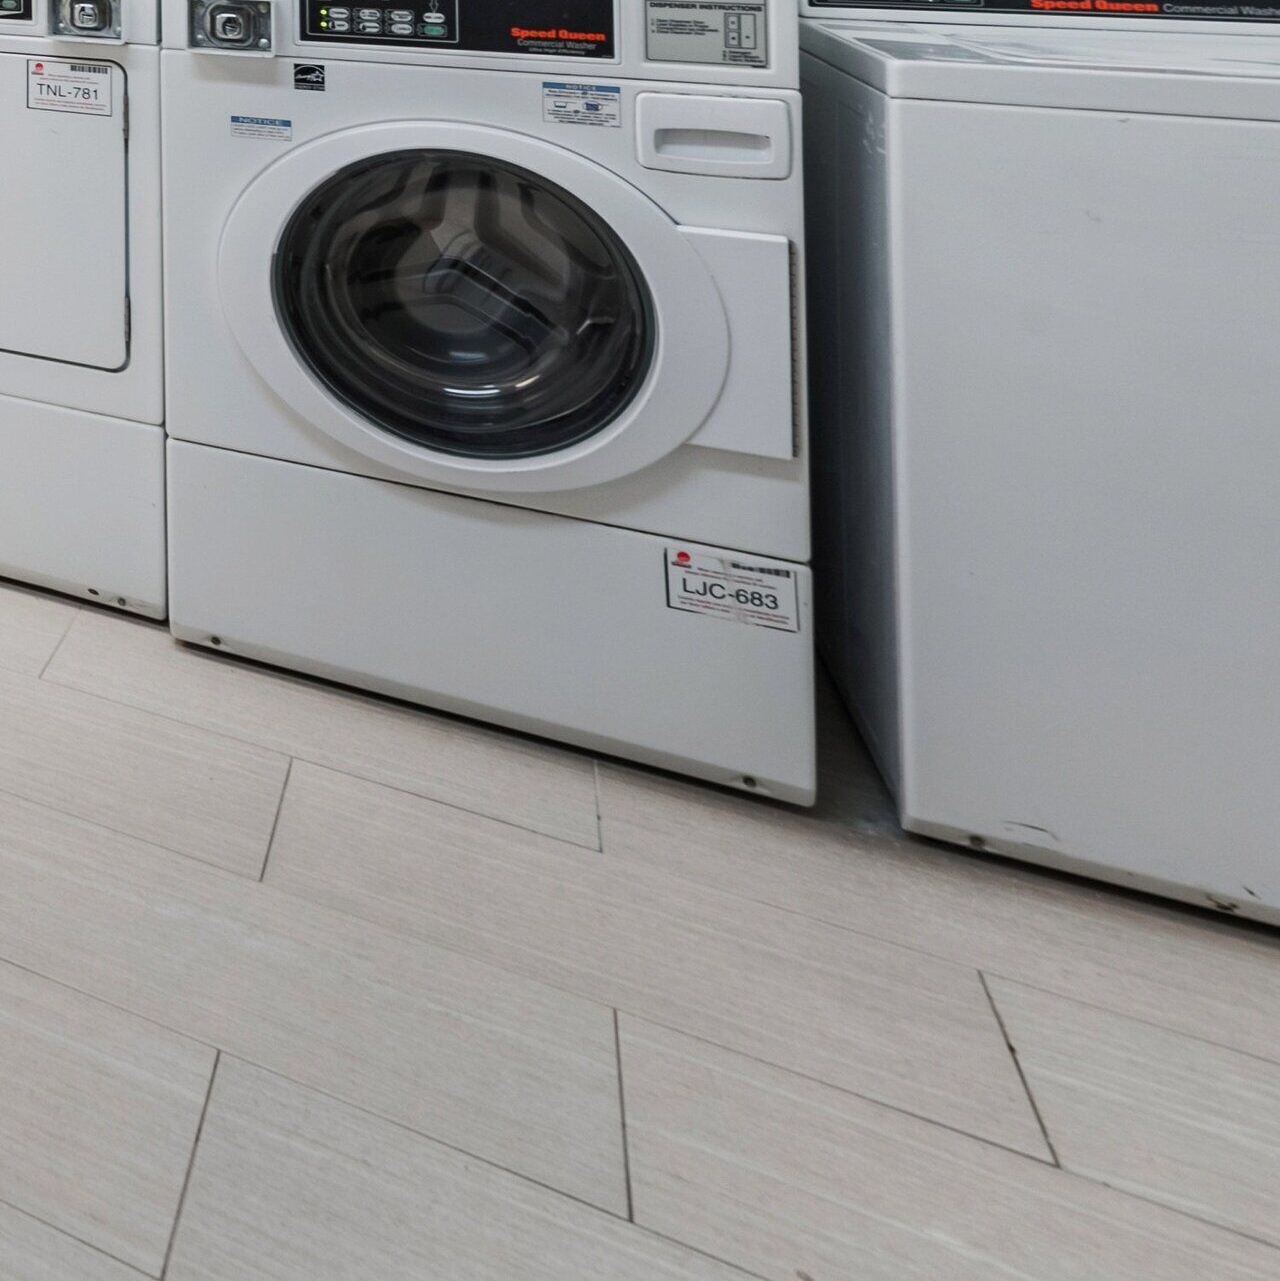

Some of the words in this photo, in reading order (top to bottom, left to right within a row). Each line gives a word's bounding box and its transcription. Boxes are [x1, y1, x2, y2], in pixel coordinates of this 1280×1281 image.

[699, 4, 762, 12] INSTRUCTIONS
[1095, 0, 1160, 12] Queen
[1162, 3, 1239, 15] Commercial
[511, 27, 556, 38] Speed
[558, 29, 606, 41] Queen
[517, 38, 564, 48] Commercial
[565, 41, 597, 50] Washer
[37, 83, 99, 100] TNL-781
[239, 117, 280, 125] NOTICE
[682, 577, 779, 610] LJC-683
